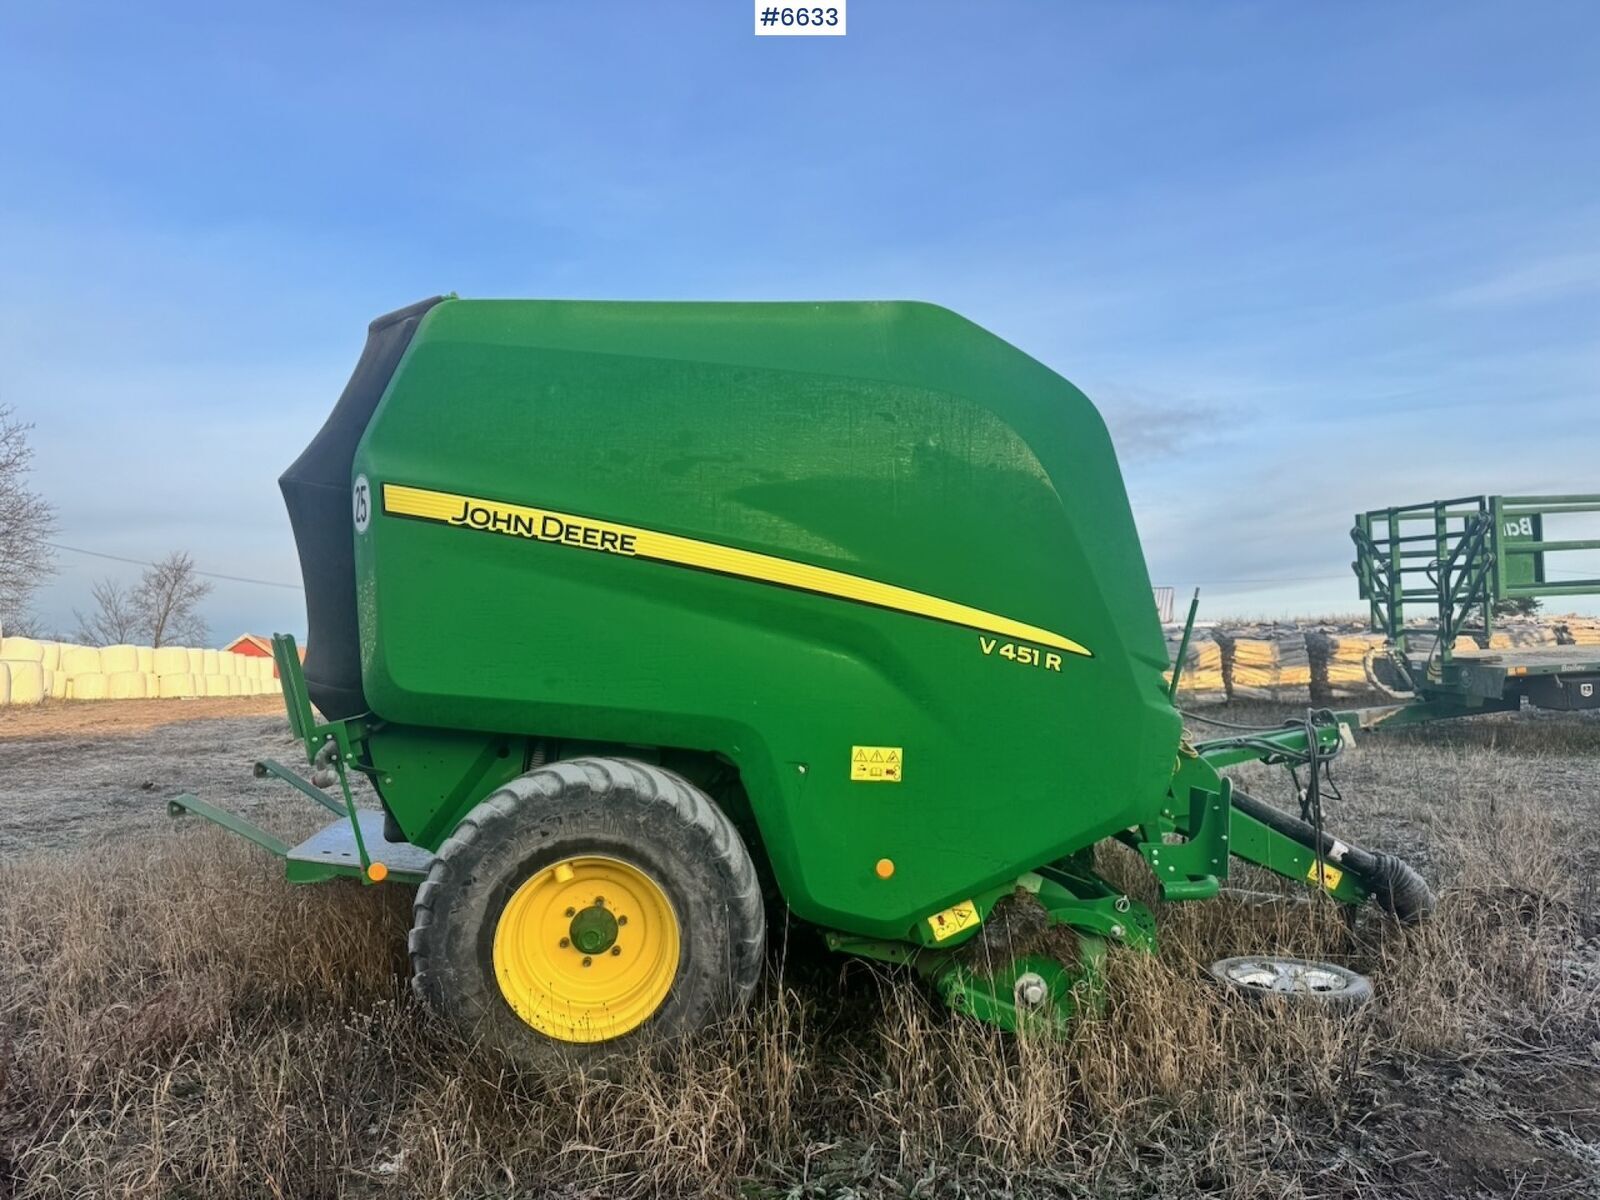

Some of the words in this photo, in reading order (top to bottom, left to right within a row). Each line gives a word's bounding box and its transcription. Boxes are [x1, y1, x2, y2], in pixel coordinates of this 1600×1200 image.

[355, 485, 367, 523] 25
[451, 501, 534, 535] JOHN
[541, 515, 637, 553] DEERE
[980, 636, 997, 655] V
[999, 643, 1040, 666] 451
[1045, 652, 1063, 672] R
